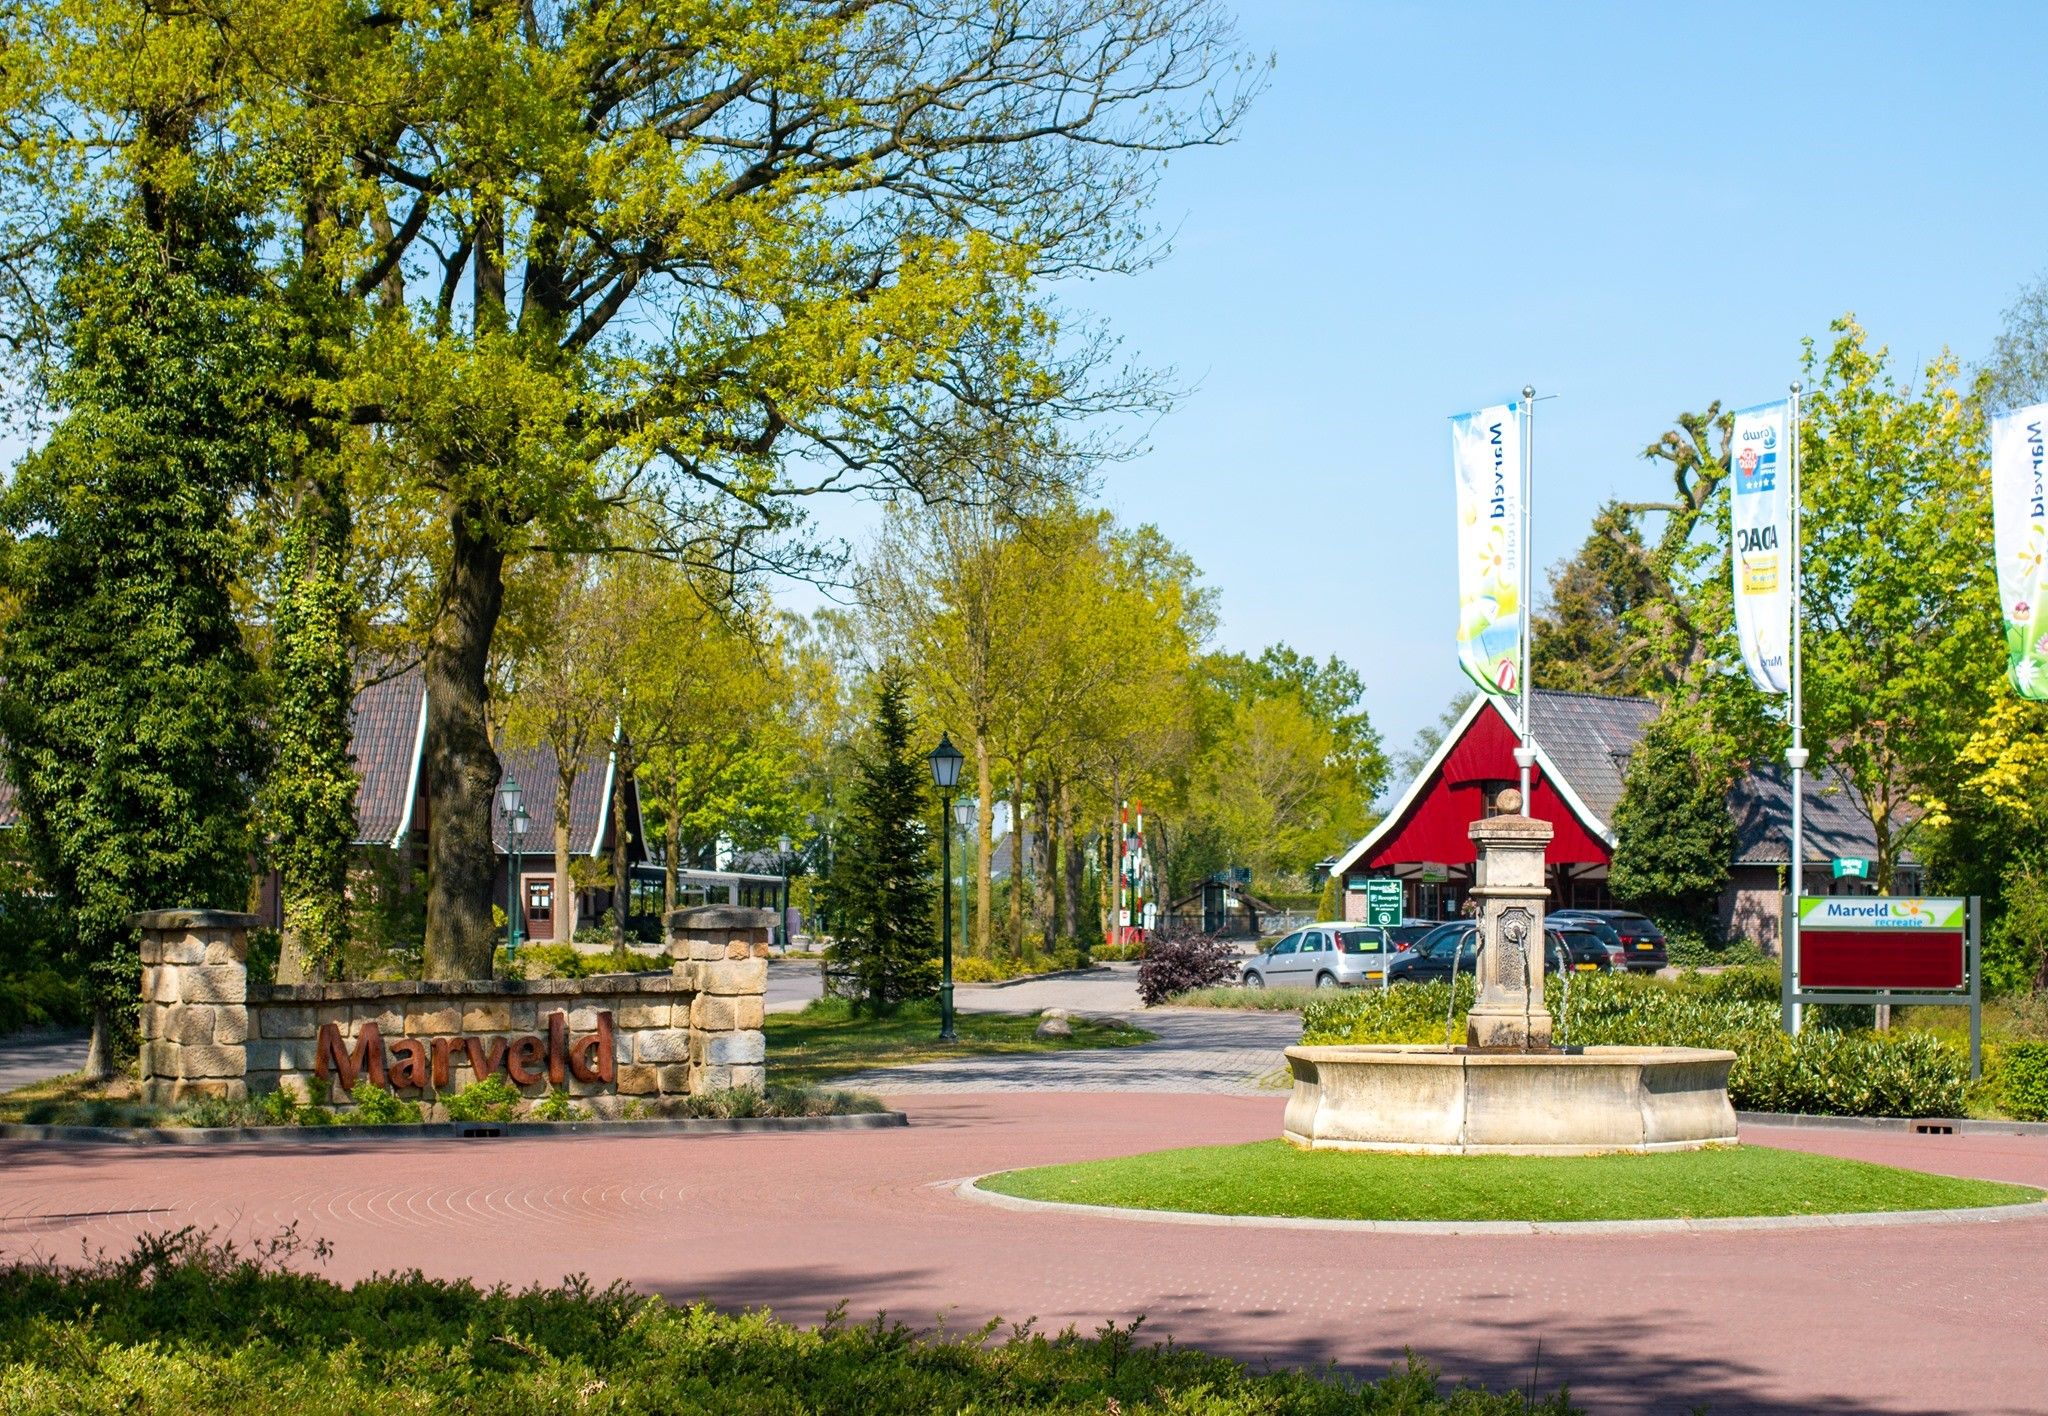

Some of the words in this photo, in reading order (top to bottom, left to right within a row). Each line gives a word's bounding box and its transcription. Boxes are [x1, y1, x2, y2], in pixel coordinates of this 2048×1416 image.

[1827, 903, 1889, 917] Marveld
[1875, 917, 1923, 927] recreatie
[314, 1011, 614, 1088] Marveld
